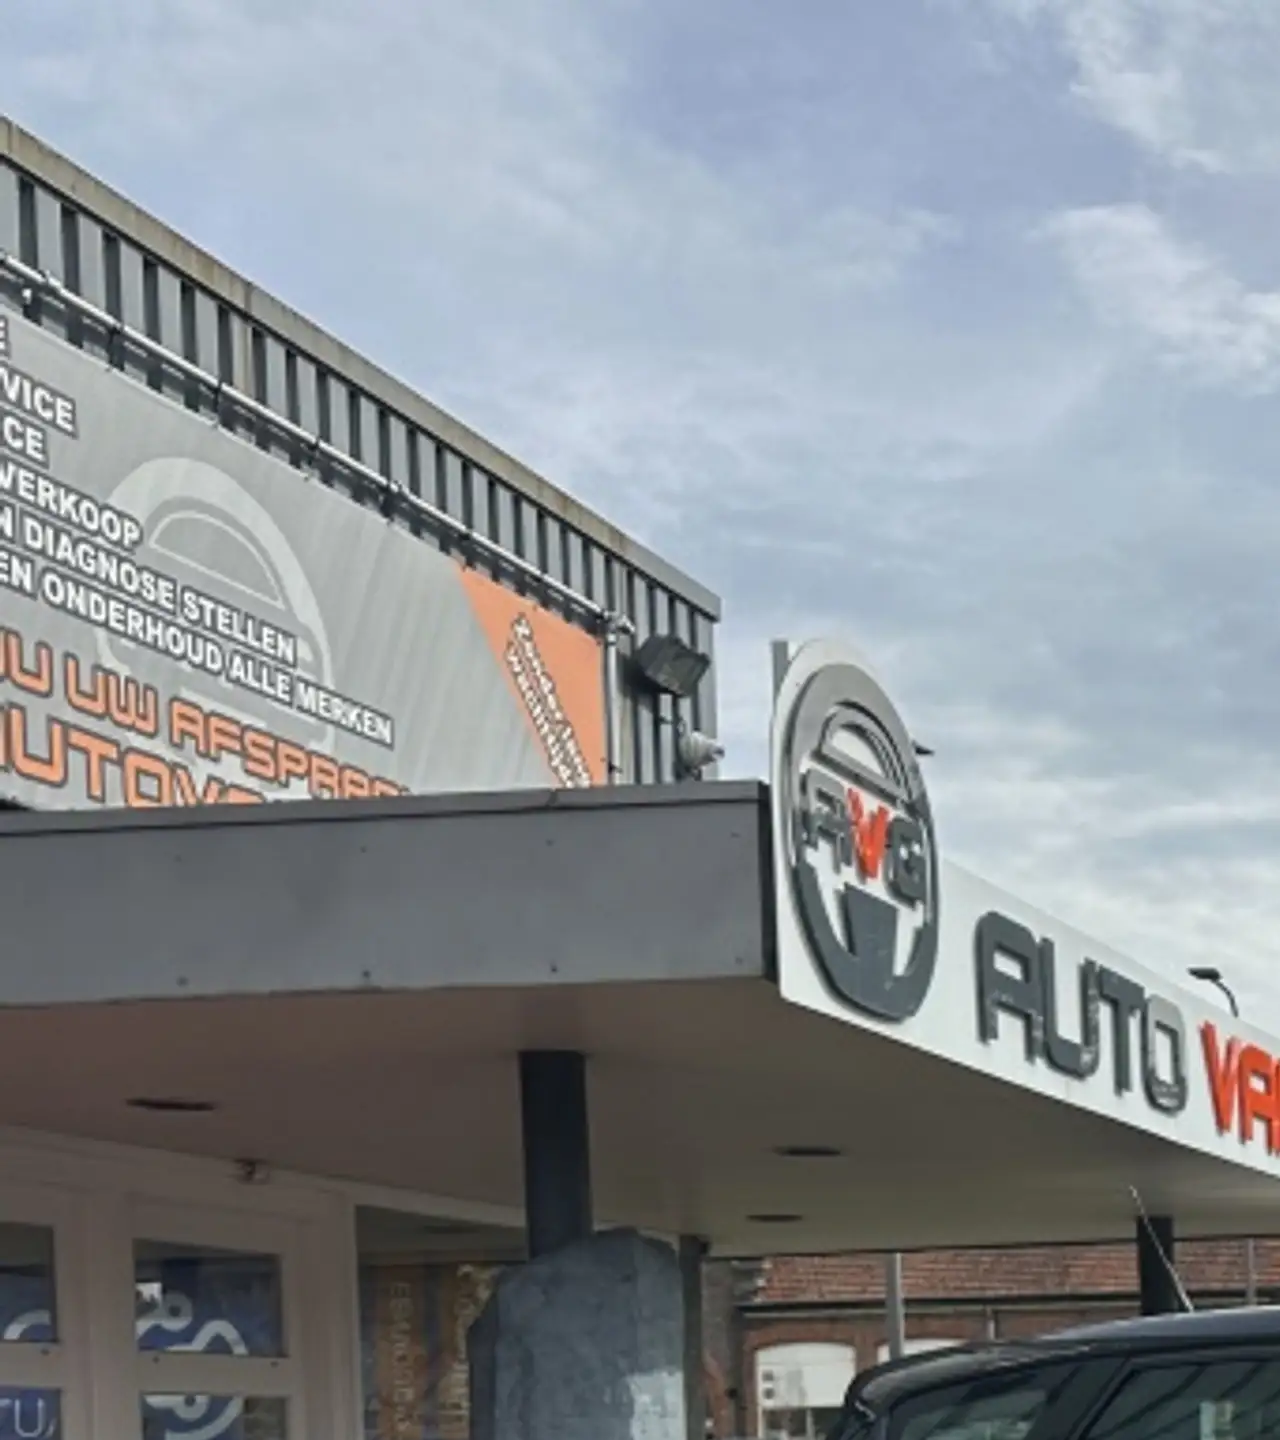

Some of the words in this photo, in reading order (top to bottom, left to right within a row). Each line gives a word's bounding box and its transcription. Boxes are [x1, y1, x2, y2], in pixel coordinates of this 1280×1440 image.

[24, 516, 175, 612] DIAGNOSE
[183, 590, 295, 666] STELLEN
[43, 572, 223, 673] ONDERHOUD
[230, 652, 292, 703] ALLE
[299, 679, 392, 745] MERKEN
[65, 653, 158, 737] UW
[974, 909, 1188, 1117] AUTO
